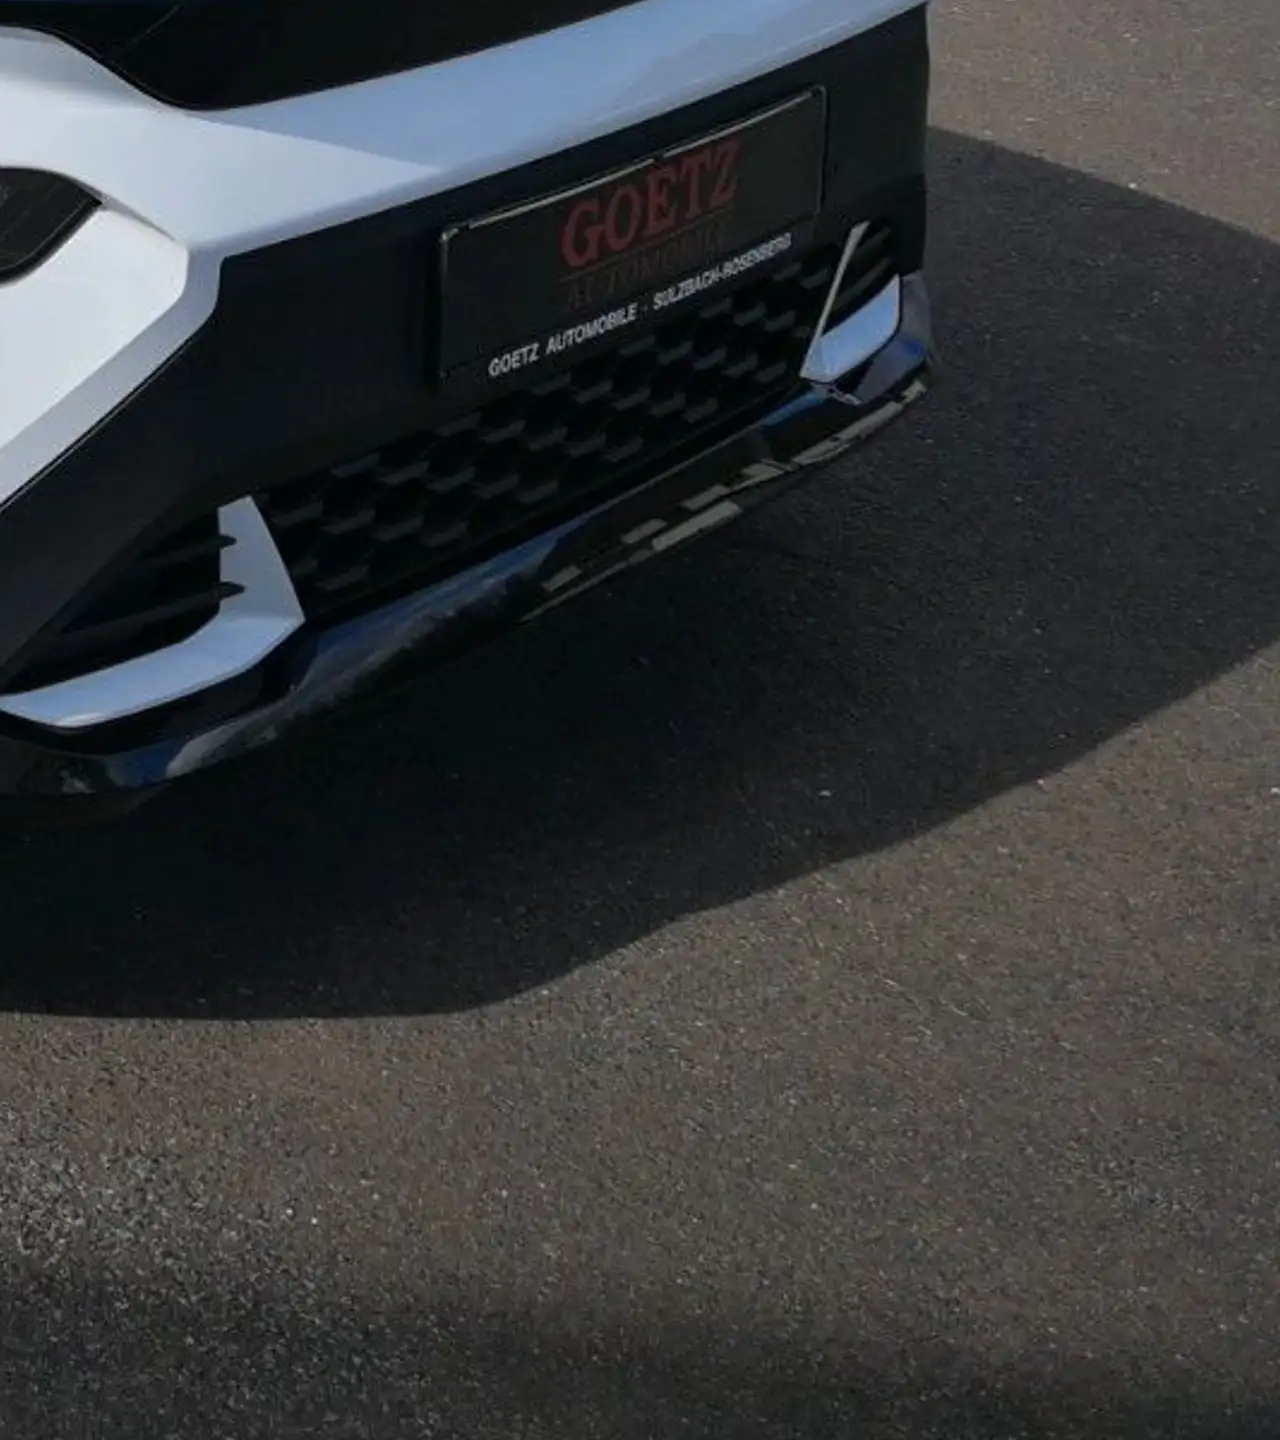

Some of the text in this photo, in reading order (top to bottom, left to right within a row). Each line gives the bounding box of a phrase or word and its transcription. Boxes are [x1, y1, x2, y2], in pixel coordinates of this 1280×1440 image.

[561, 138, 740, 266] GOETZ
[488, 232, 793, 378] GOETZ AUTOMOBILE SULZBACH-ROSENBERG
